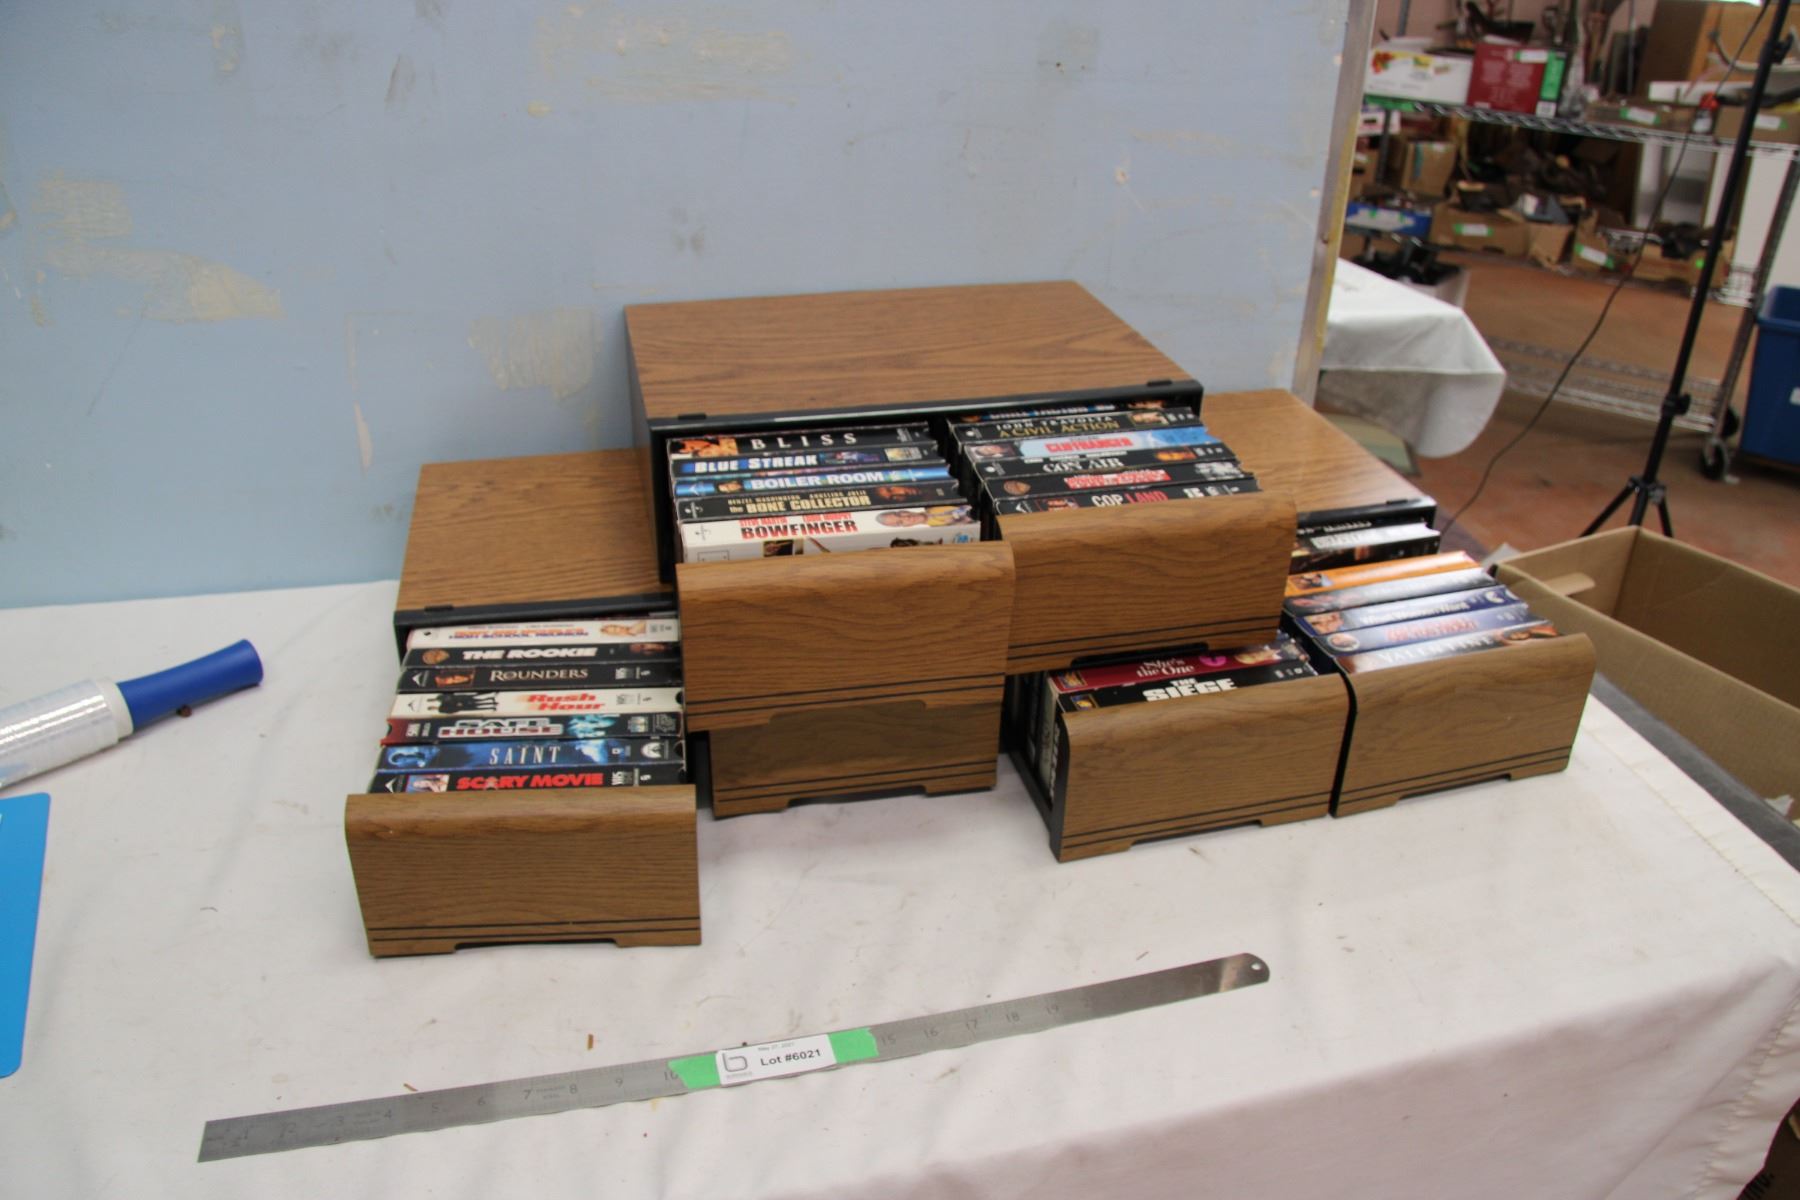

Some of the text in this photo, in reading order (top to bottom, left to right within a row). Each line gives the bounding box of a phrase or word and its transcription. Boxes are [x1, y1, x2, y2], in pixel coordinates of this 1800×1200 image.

[996, 415, 1113, 431] JOHN TRAVOLTA
[1000, 421, 1120, 438] A CIVIL ACTION
[750, 432, 858, 450] BLISS
[694, 454, 818, 474] BLUE STREAK
[1042, 457, 1125, 473] CON AIR
[751, 471, 885, 490] BOILER ROOM
[729, 494, 872, 514] the BONE COLLECTOR
[1091, 494, 1124, 508] COP
[1124, 490, 1169, 504] LAND
[740, 519, 860, 540] BOWFINGER
[462, 647, 599, 660] THE ROOKIE
[489, 668, 589, 682] ROUNDERS
[1136, 664, 1195, 677] the One
[1142, 677, 1238, 702] SIEGE
[1170, 677, 1199, 687] THE
[525, 692, 597, 703] Rush
[537, 702, 605, 711] Hour
[489, 746, 561, 765] SAINT
[456, 772, 604, 791] SCARY MOVIE
[760, 1048, 821, 1066] Lot #6021
